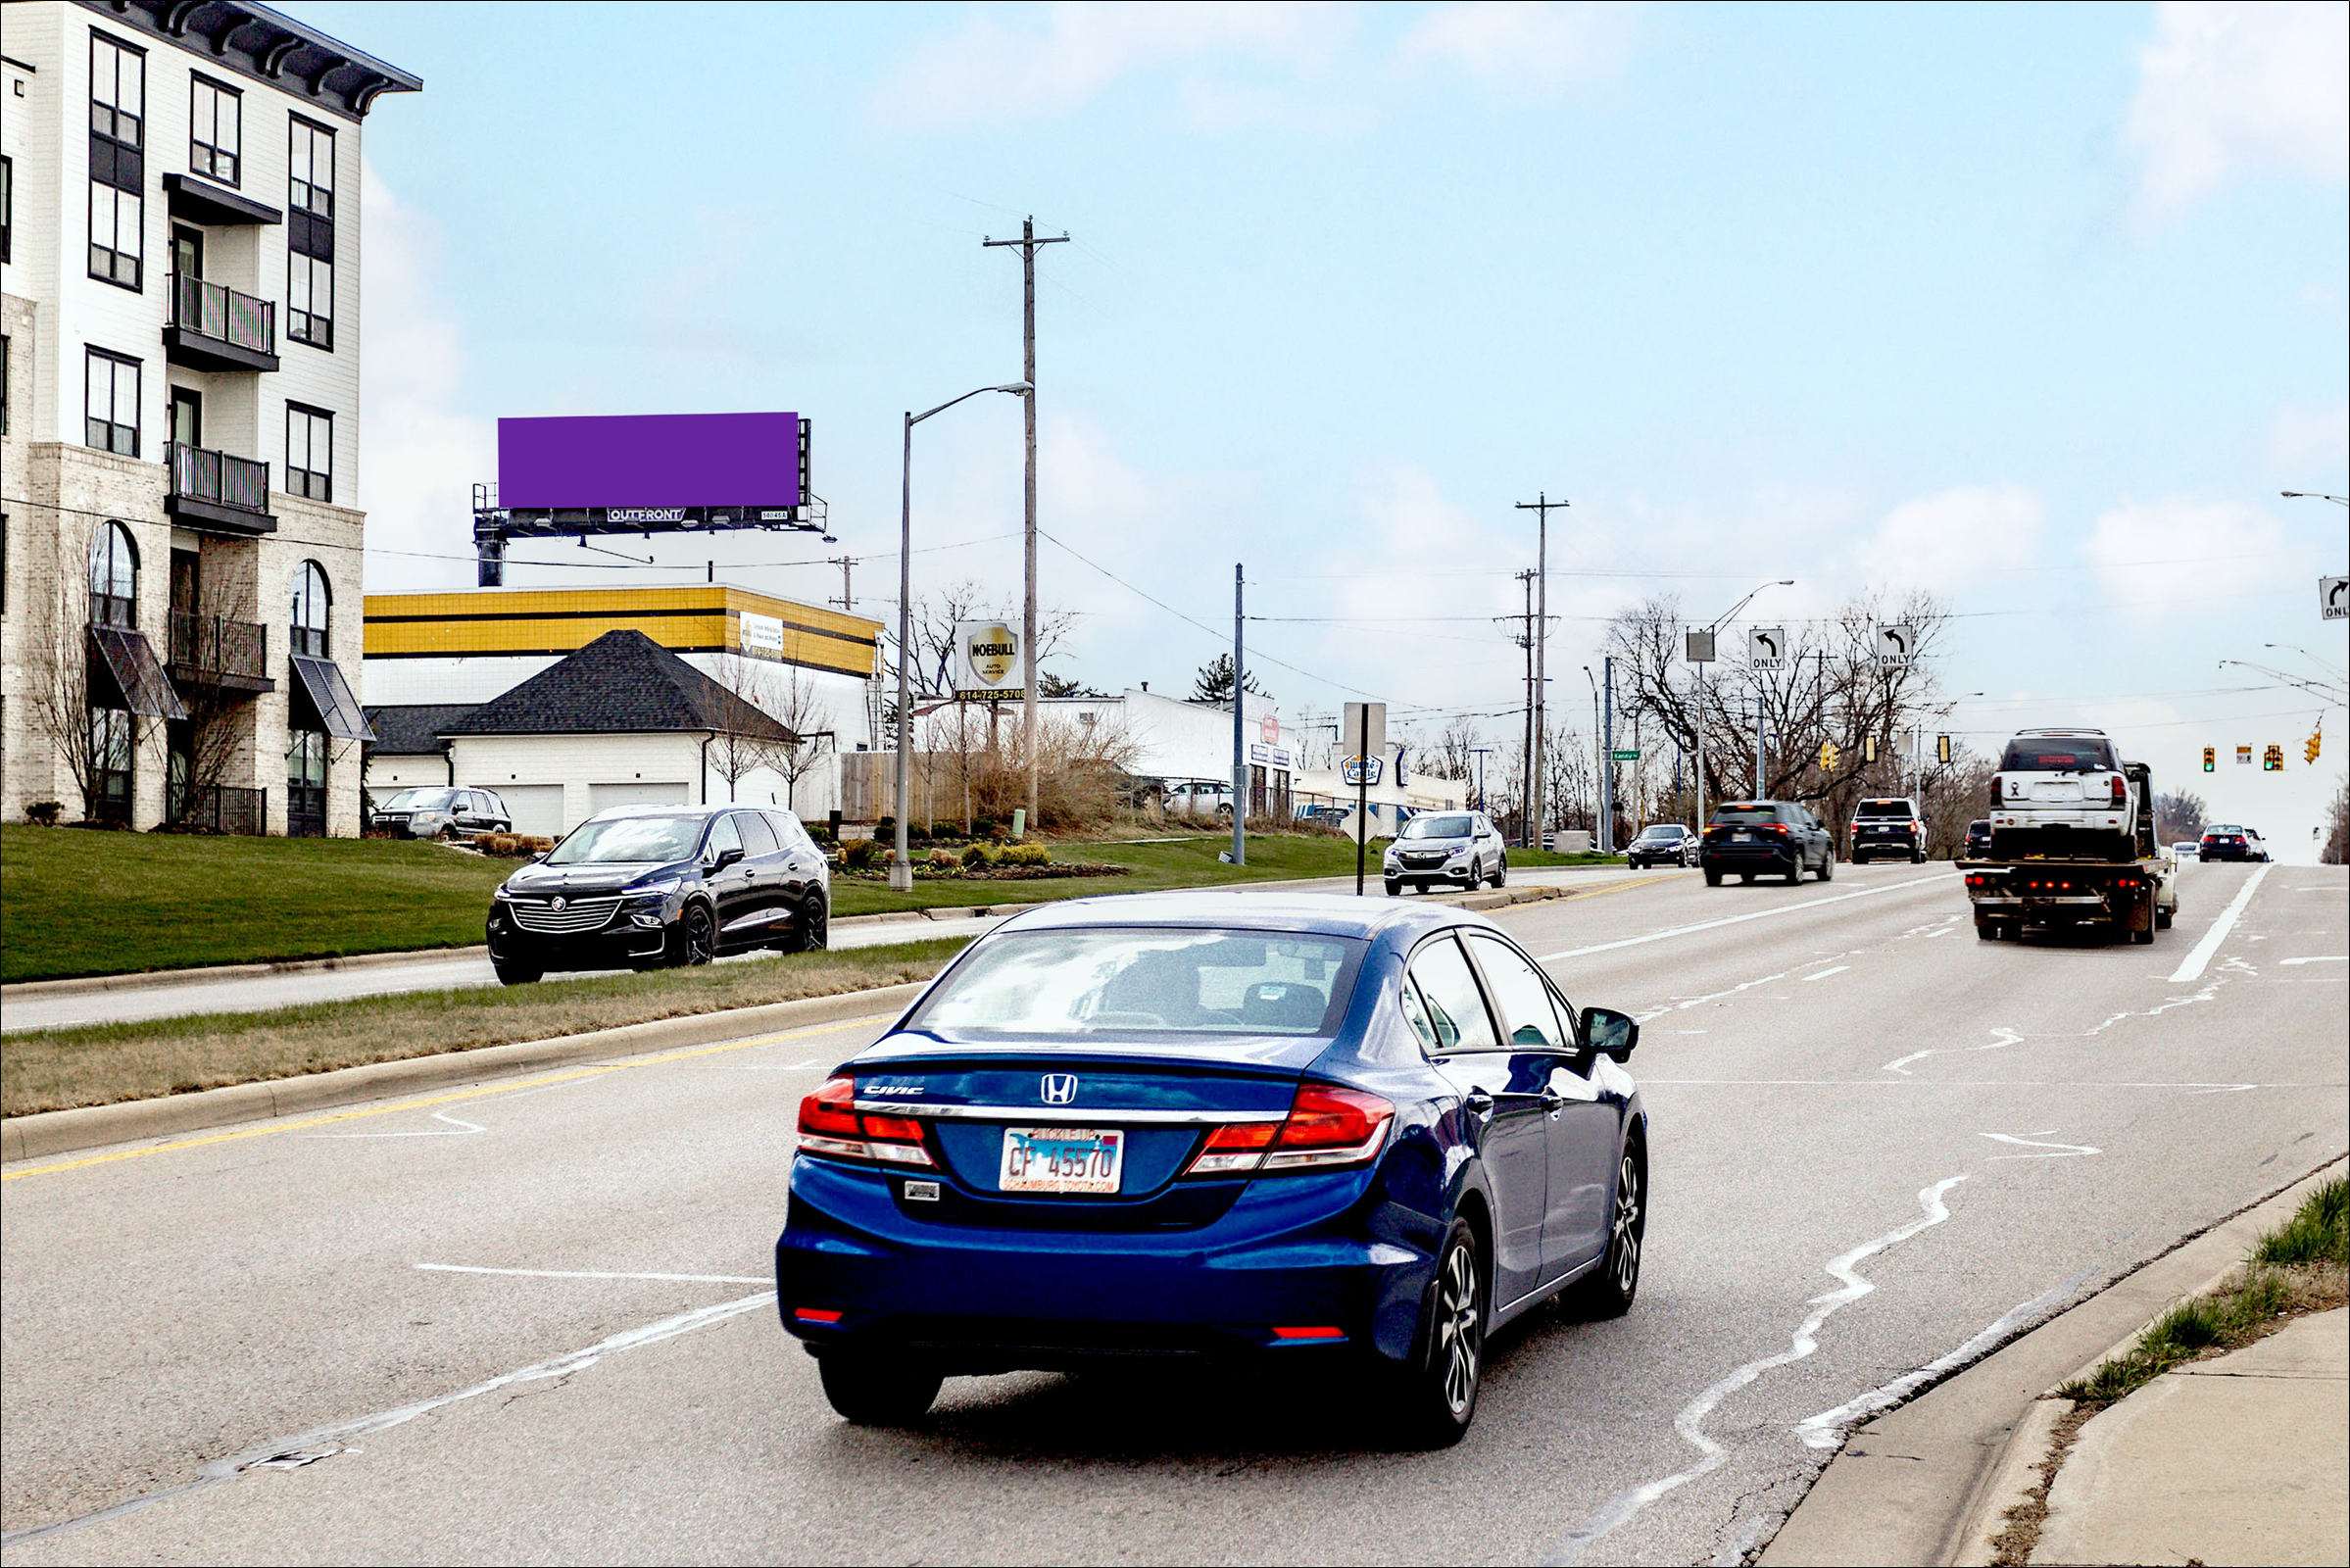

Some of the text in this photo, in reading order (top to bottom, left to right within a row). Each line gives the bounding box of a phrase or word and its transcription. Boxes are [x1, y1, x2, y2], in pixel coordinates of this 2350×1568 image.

[611, 509, 682, 520] OUTFRONT
[2326, 606, 2349, 617] ONL
[972, 643, 1014, 657] NOEBULL
[1753, 658, 1782, 668] ONLY
[1882, 654, 1910, 665] ONLY
[1349, 760, 1375, 769] Wte
[1346, 768, 1376, 777] Cale
[863, 1085, 925, 1096] CIVIC
[1032, 1128, 1096, 1142] BUCKLE UP
[1008, 1147, 1112, 1178] CF 45570
[1003, 1178, 1059, 1192] SCHAUMBURG
